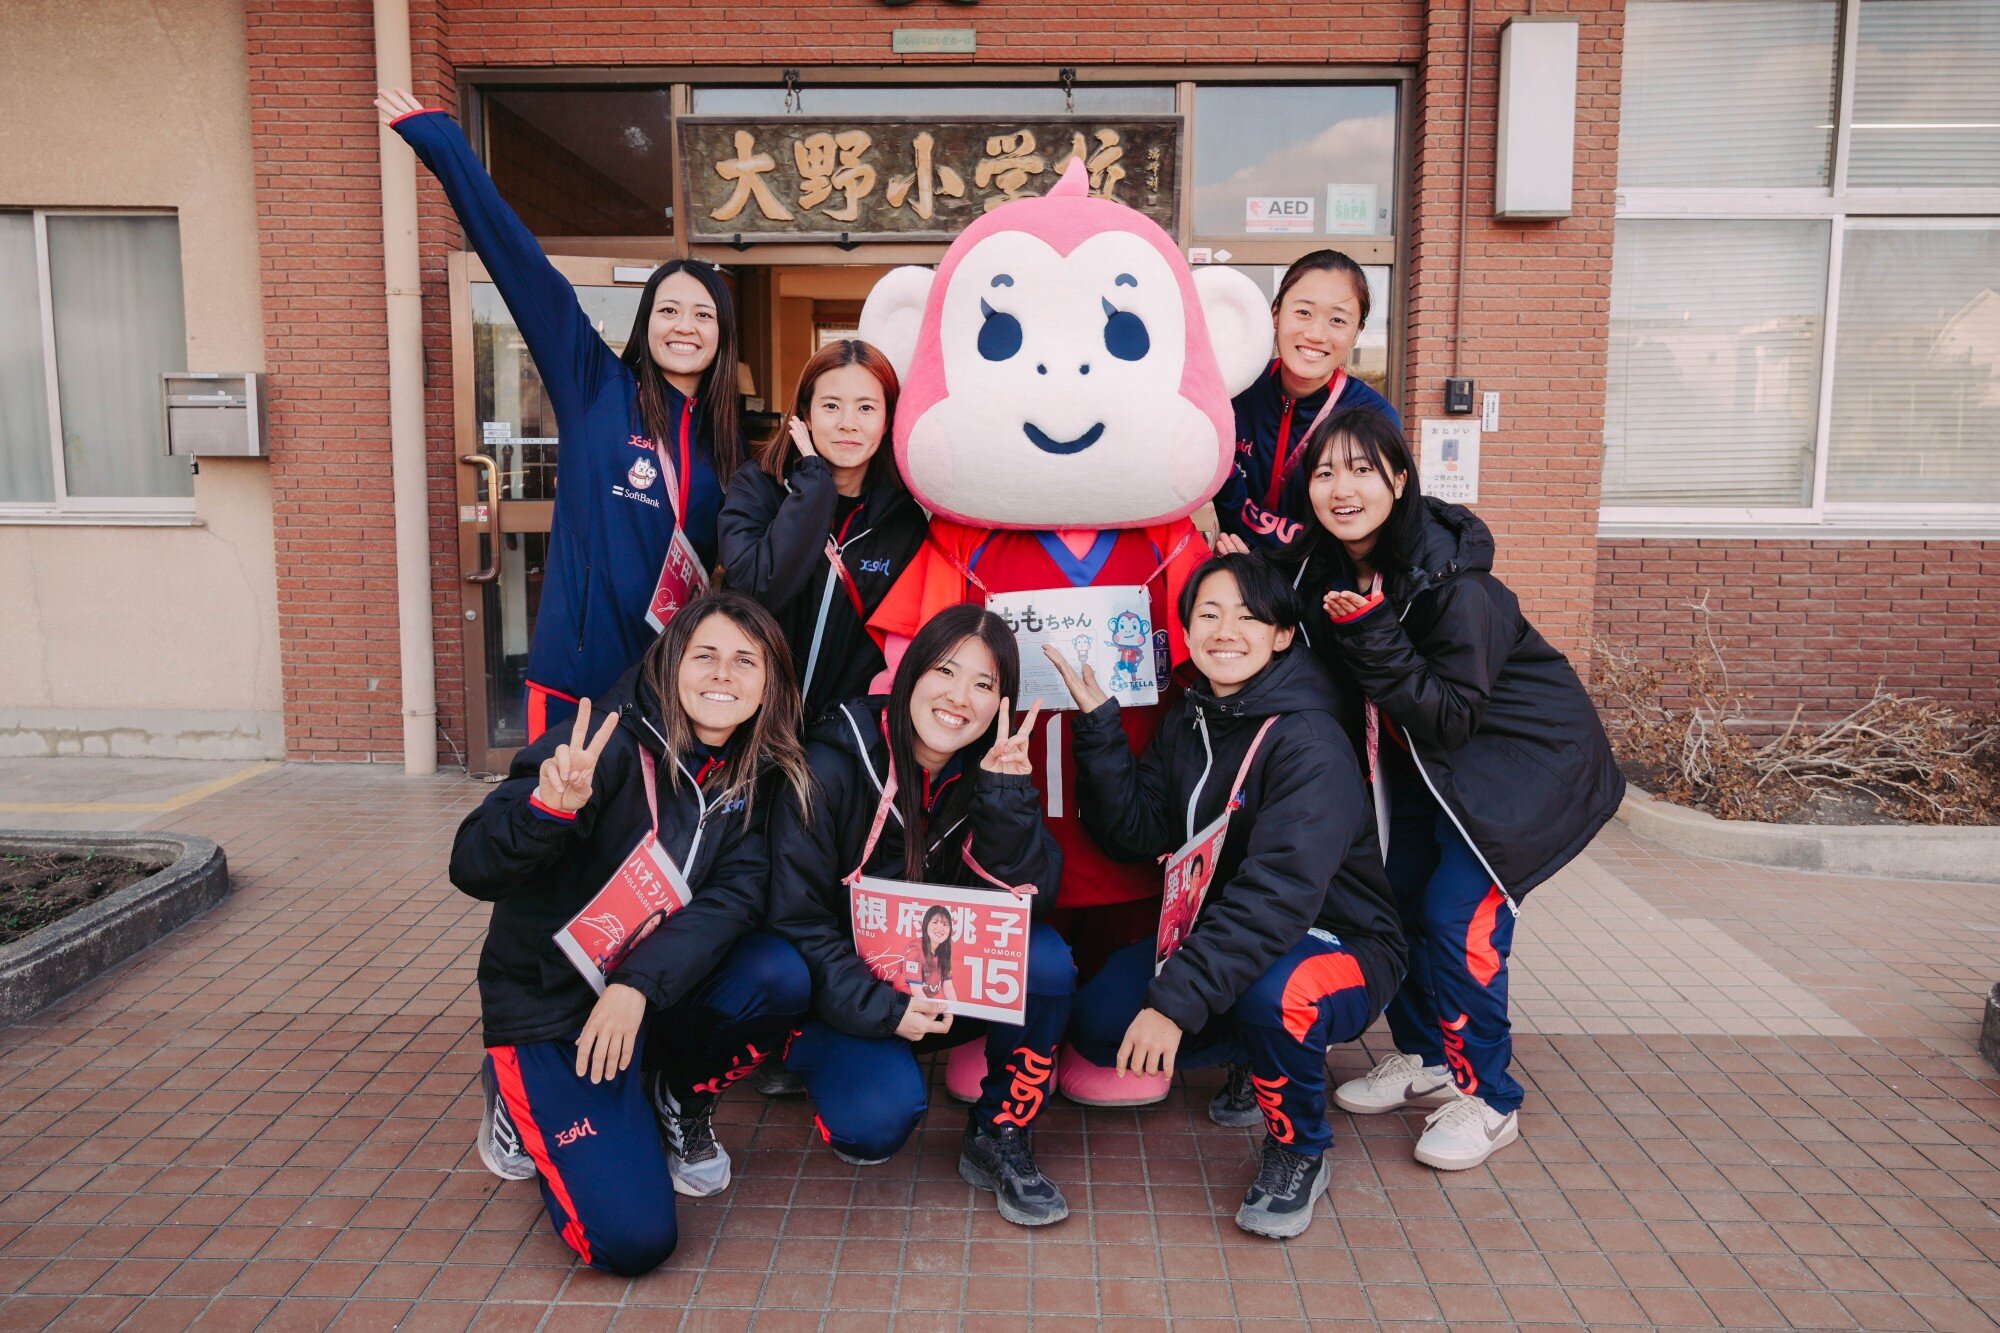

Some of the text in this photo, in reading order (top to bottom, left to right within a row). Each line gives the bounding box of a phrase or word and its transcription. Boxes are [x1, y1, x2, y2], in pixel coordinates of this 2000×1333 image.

[1268, 200, 1309, 215] AED
[624, 489, 660, 508] SoftBank
[1000, 604, 1092, 633] ももちゃん
[621, 869, 638, 891] PAOLA
[857, 928, 876, 938] NEBU
[983, 947, 1022, 957] MOMOKO
[963, 955, 1020, 1004] 15
